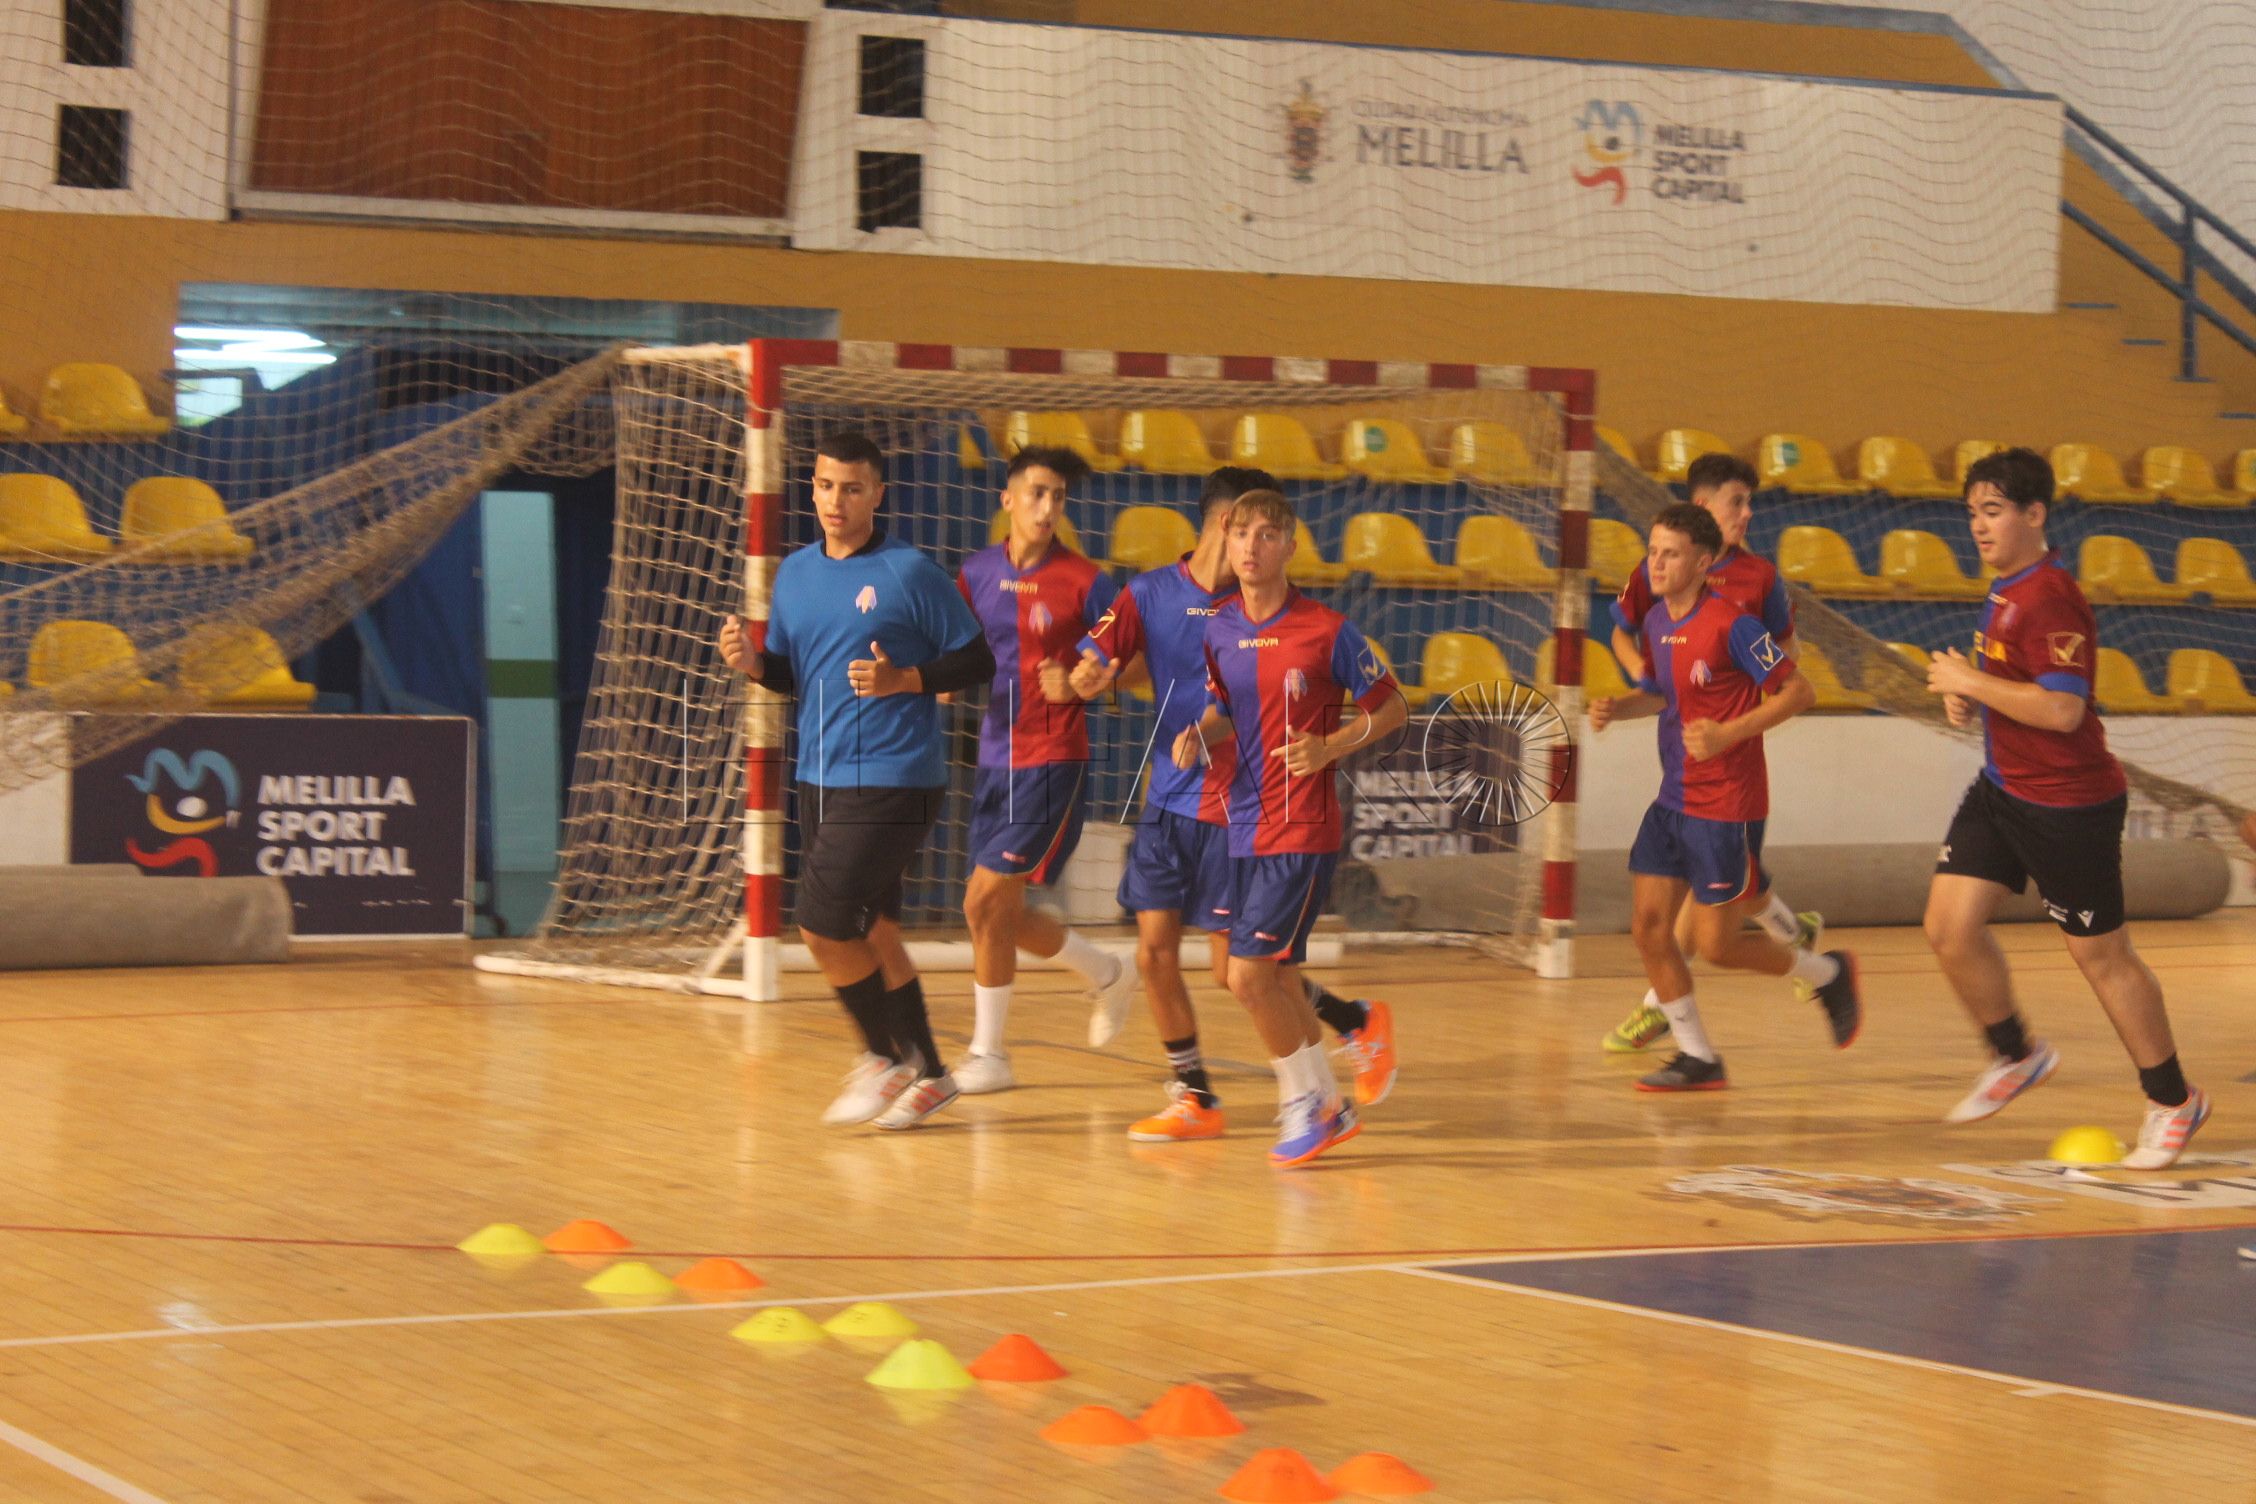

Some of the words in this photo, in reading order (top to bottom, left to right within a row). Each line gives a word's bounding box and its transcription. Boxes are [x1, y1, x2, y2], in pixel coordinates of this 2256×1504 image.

[1356, 123, 1530, 174] MELILLA
[1654, 124, 1746, 151] MELILLA
[1652, 150, 1728, 176] SPORT
[1651, 175, 1746, 203] CAPITAL
[1239, 638, 1279, 649] GIVOVA
[257, 775, 416, 806] MELILLA
[257, 810, 387, 842] SPORT
[1353, 802, 1455, 829] SPORT
[1350, 835, 1474, 860] CAPITAL
[255, 846, 416, 877] CAPITAL
